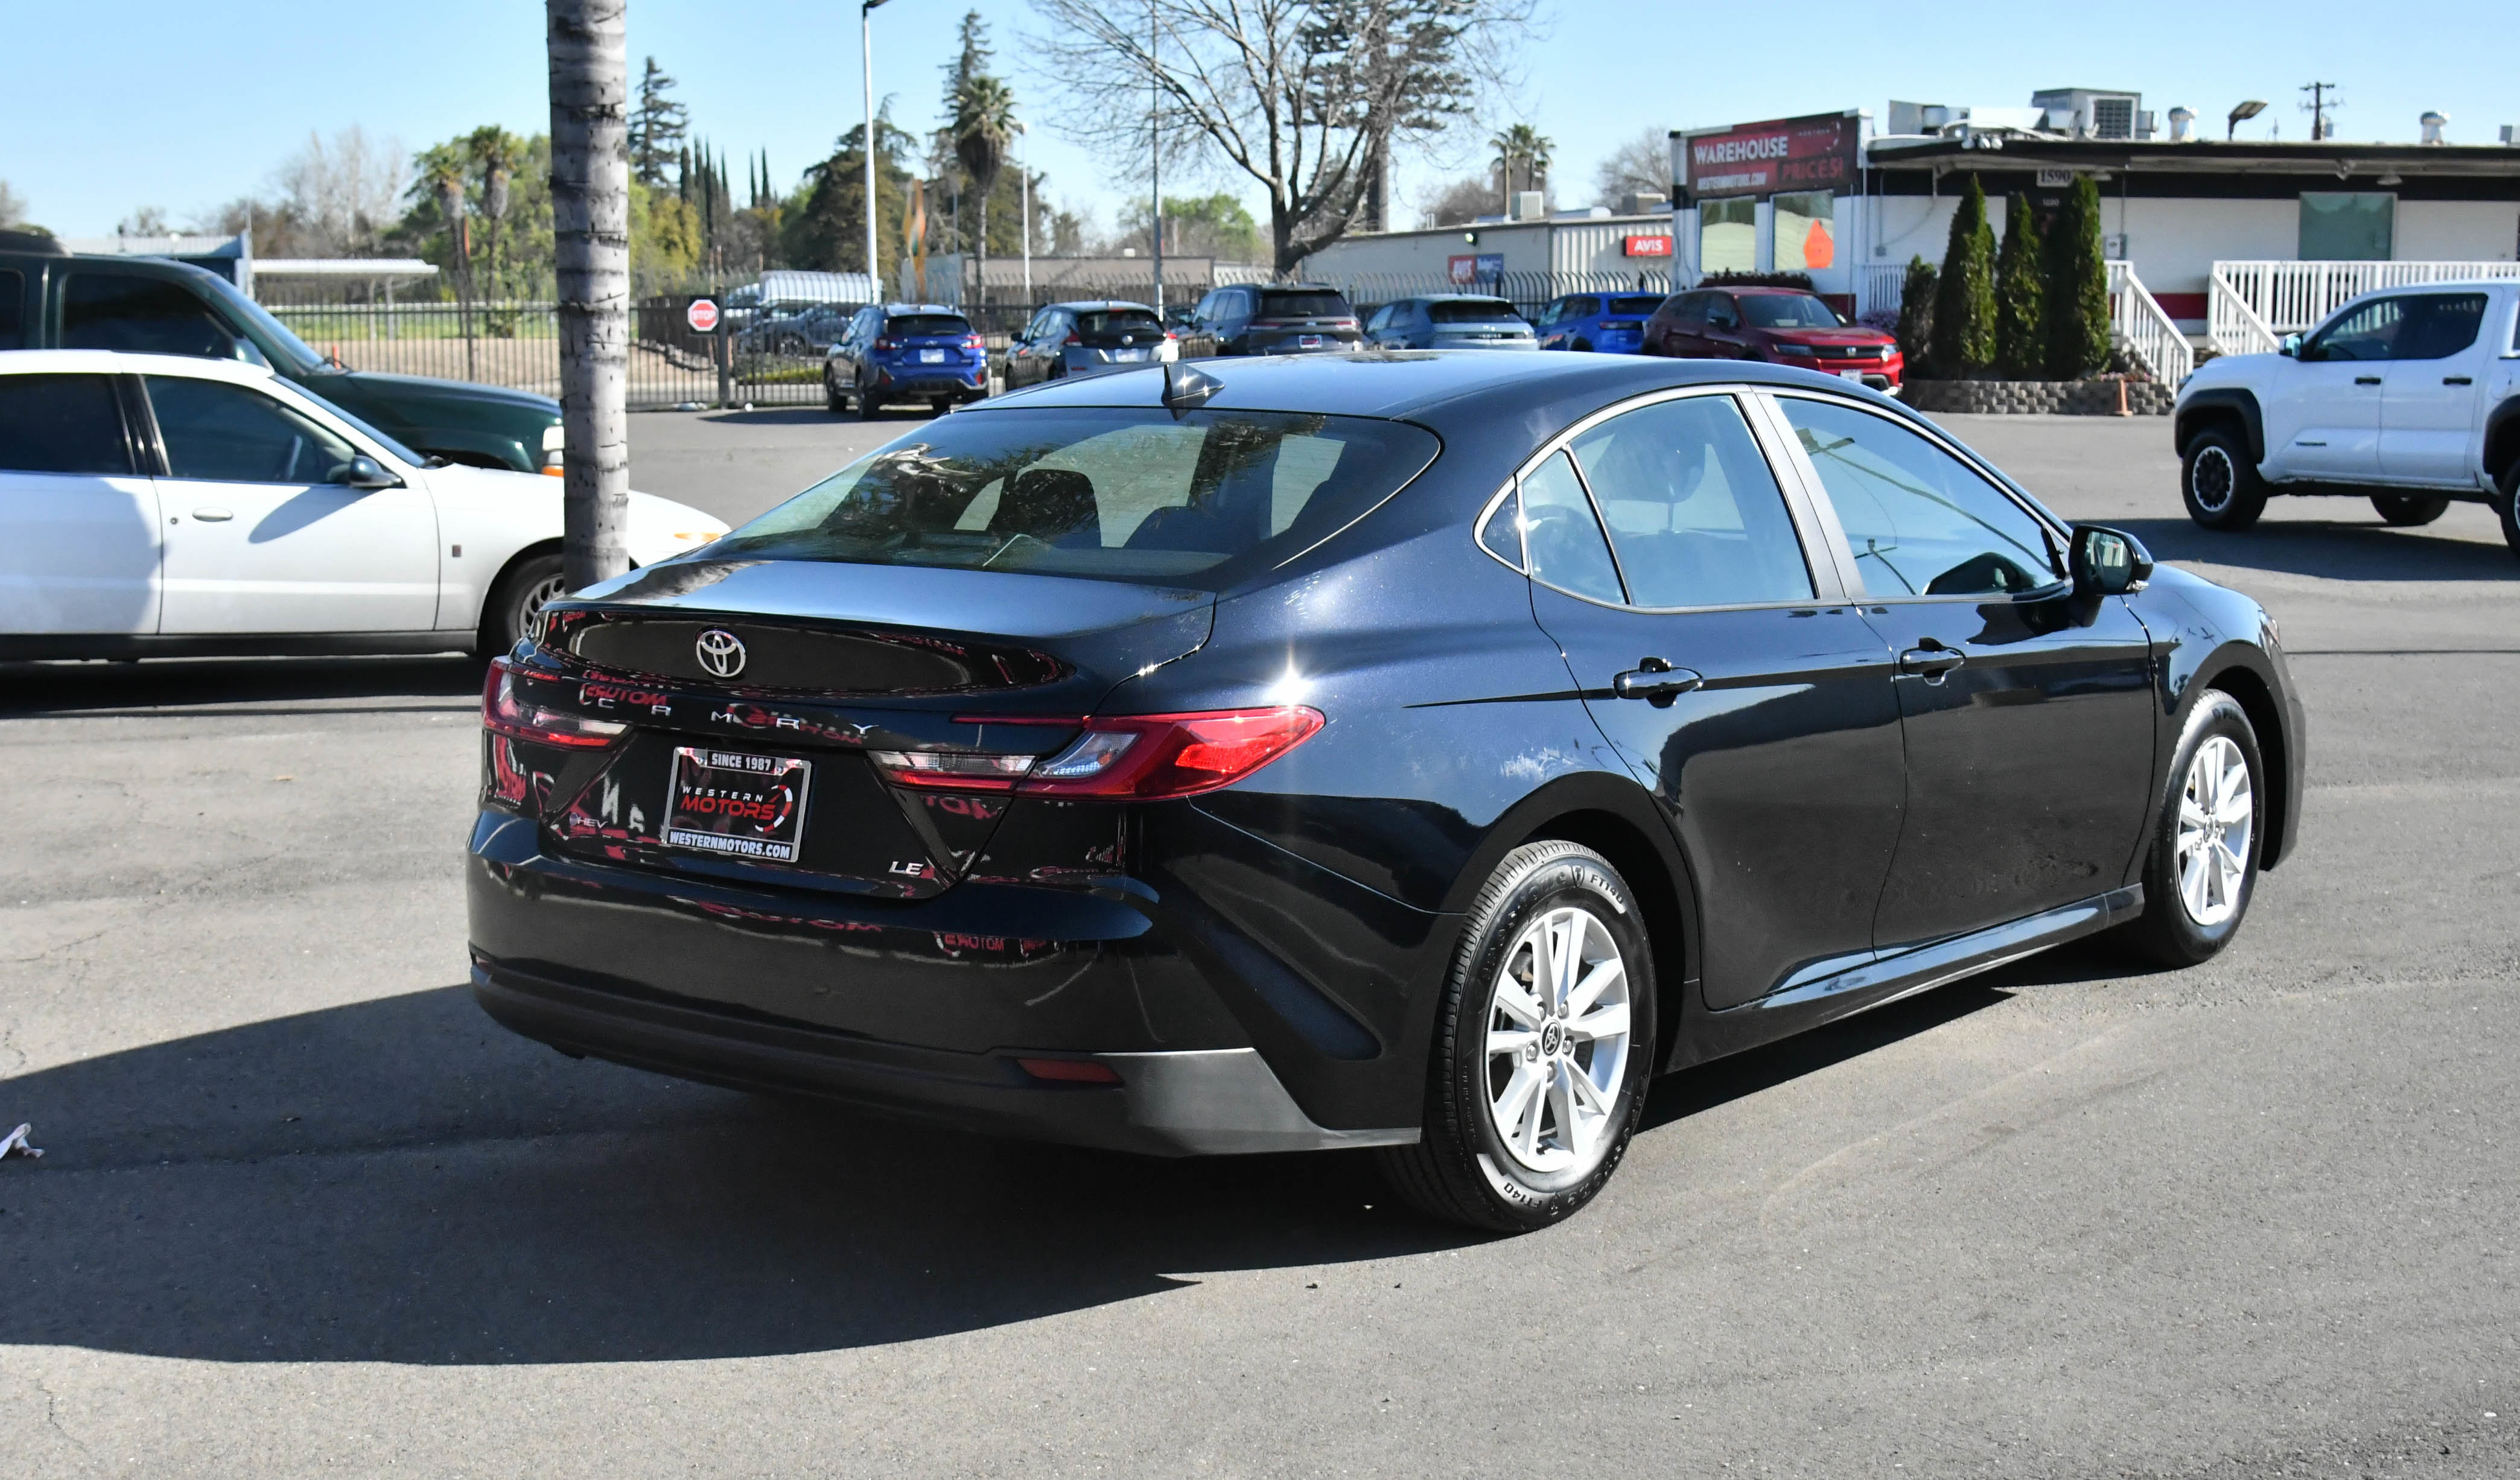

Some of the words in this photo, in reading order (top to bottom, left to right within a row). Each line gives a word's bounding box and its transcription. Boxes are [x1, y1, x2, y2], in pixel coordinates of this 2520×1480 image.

[1694, 135, 1789, 165] WAREHOUSE
[1634, 240, 1664, 252] AVIS
[692, 308, 716, 321] STOP
[597, 697, 879, 735] CAMRY
[711, 752, 742, 768] SINCE
[745, 757, 771, 770] 1987
[682, 786, 763, 802] WESTERN
[681, 795, 776, 820] MOTORS
[577, 816, 608, 829] HEV
[669, 831, 791, 859] WESTERNMOTORS.COM
[888, 860, 924, 876] LE
[1589, 873, 1624, 905] FT140
[1503, 1181, 1544, 1209] FT140
